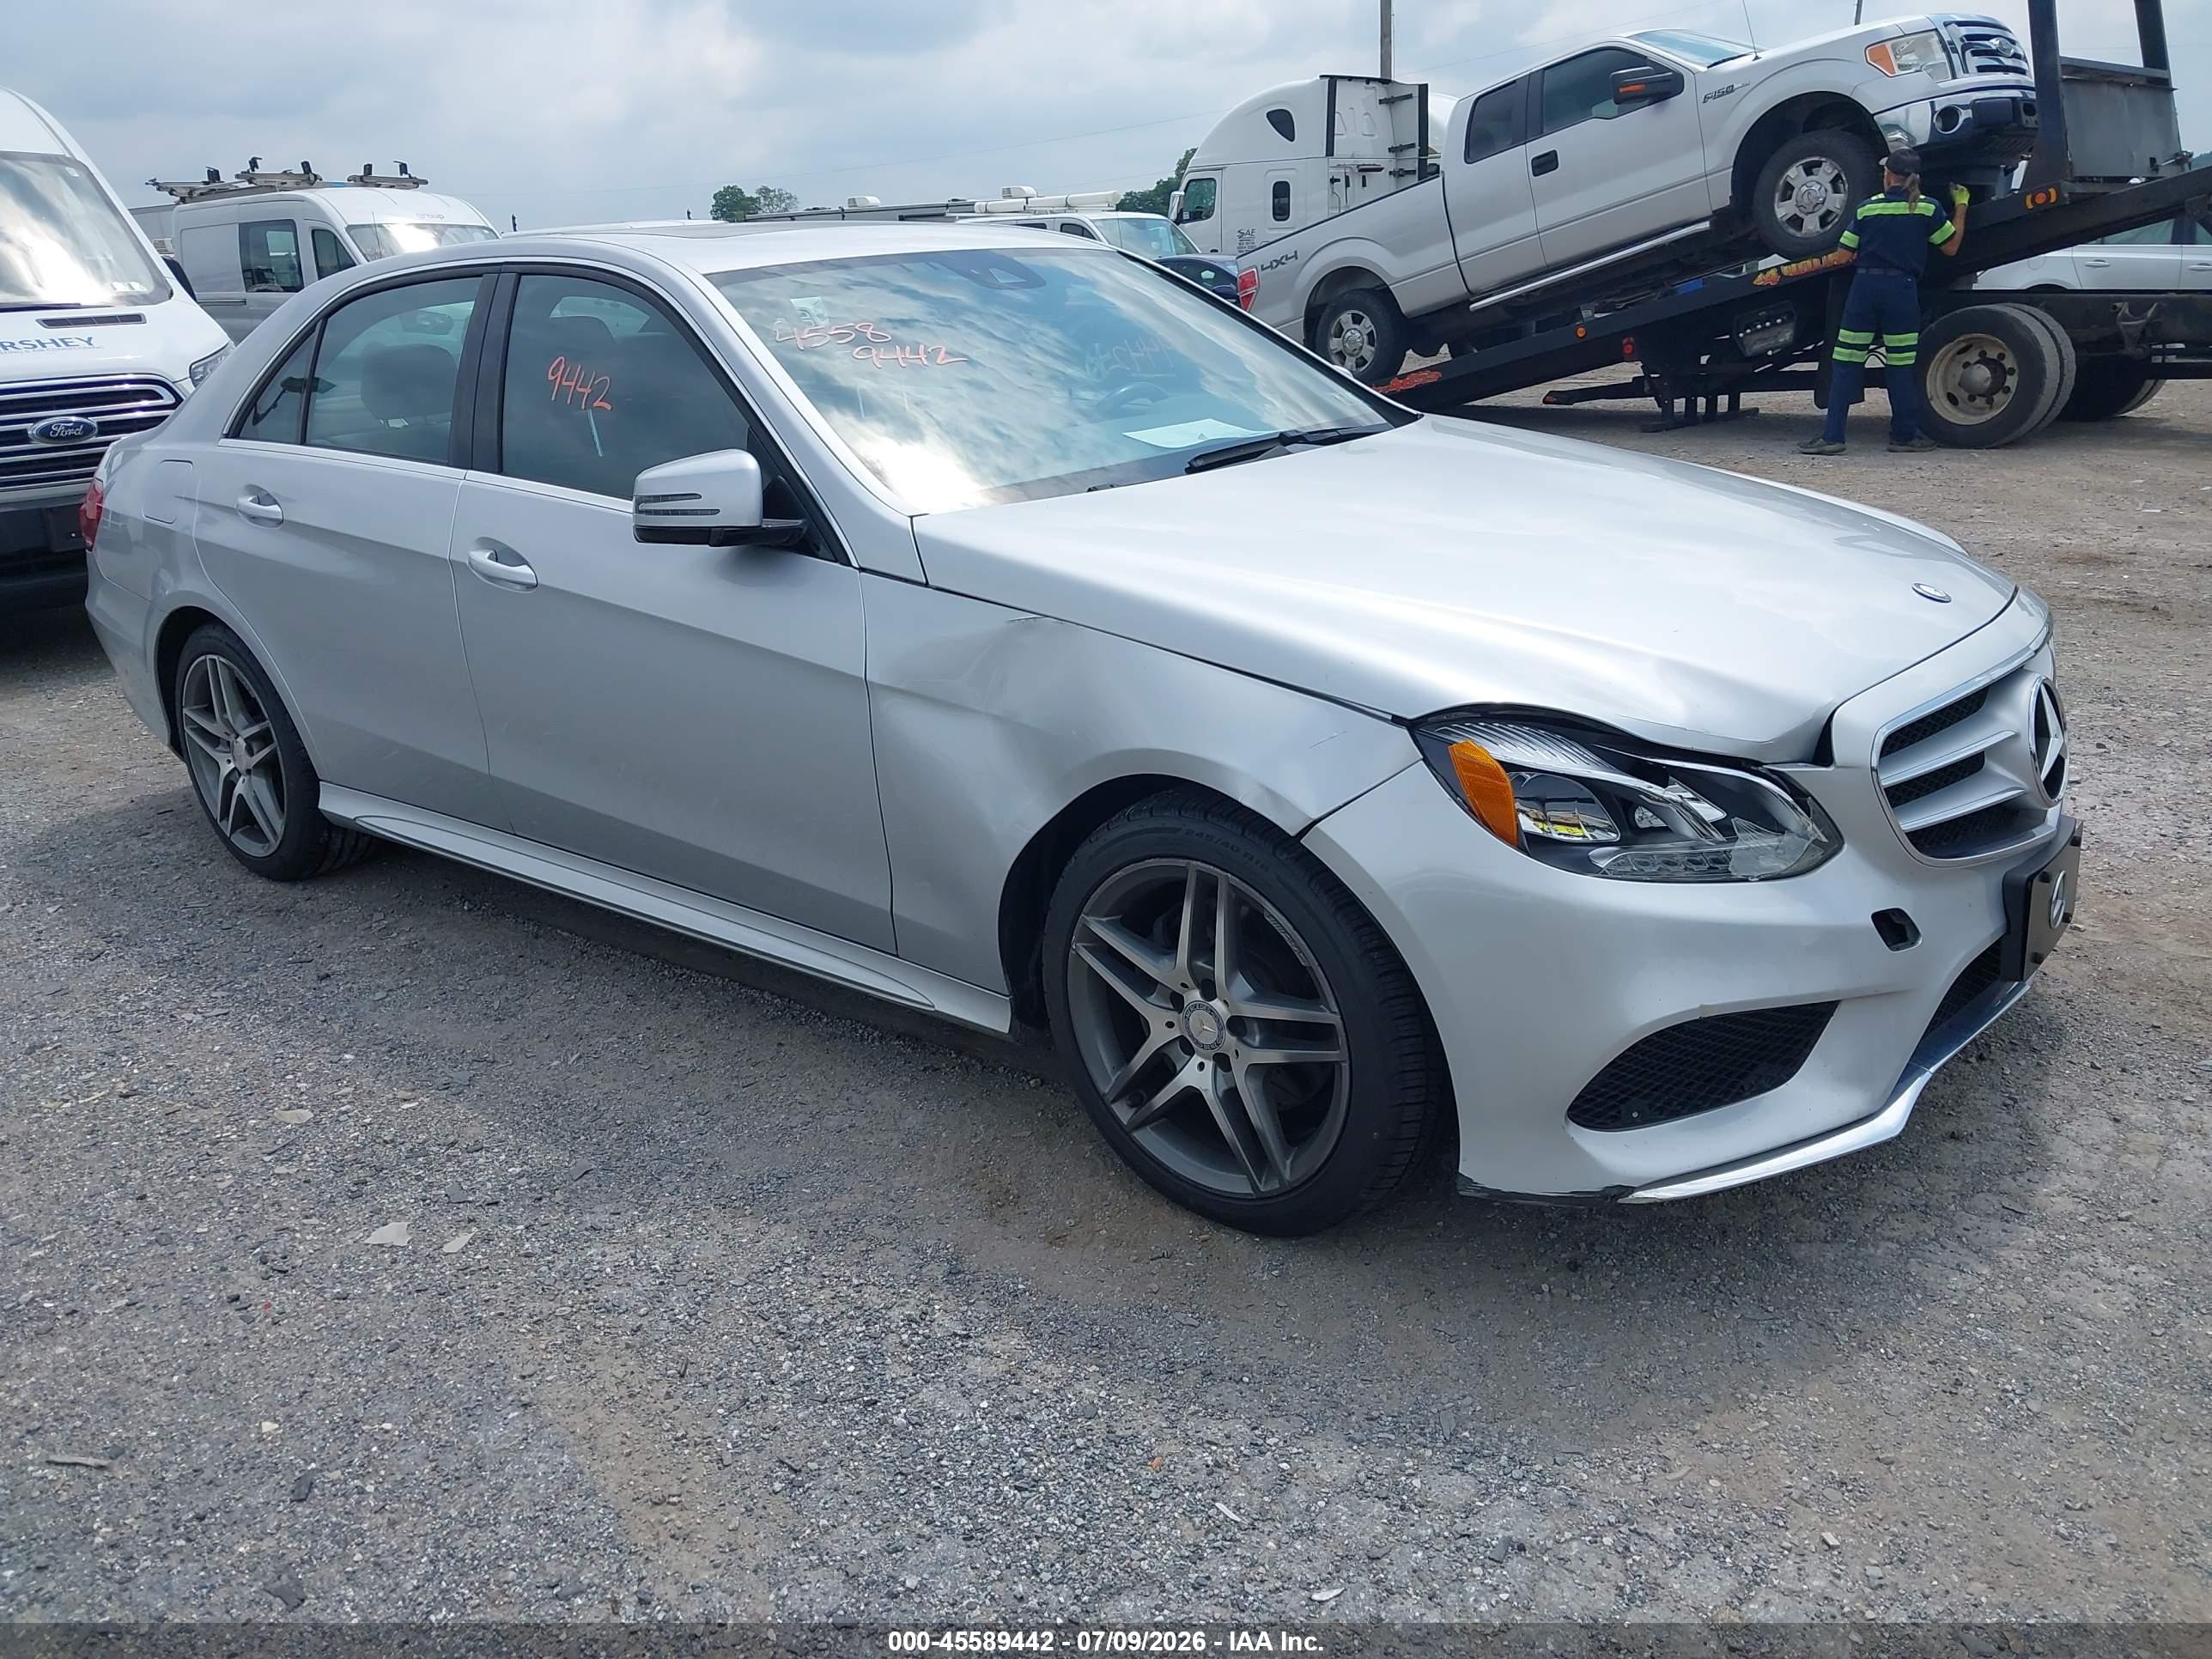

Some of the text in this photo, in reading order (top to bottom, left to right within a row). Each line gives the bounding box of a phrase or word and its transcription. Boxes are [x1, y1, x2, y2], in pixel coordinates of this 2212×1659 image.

[775, 322, 892, 350] 4558
[852, 343, 969, 369] 9442
[548, 356, 613, 411] 9442
[49, 422, 83, 437] Ford
